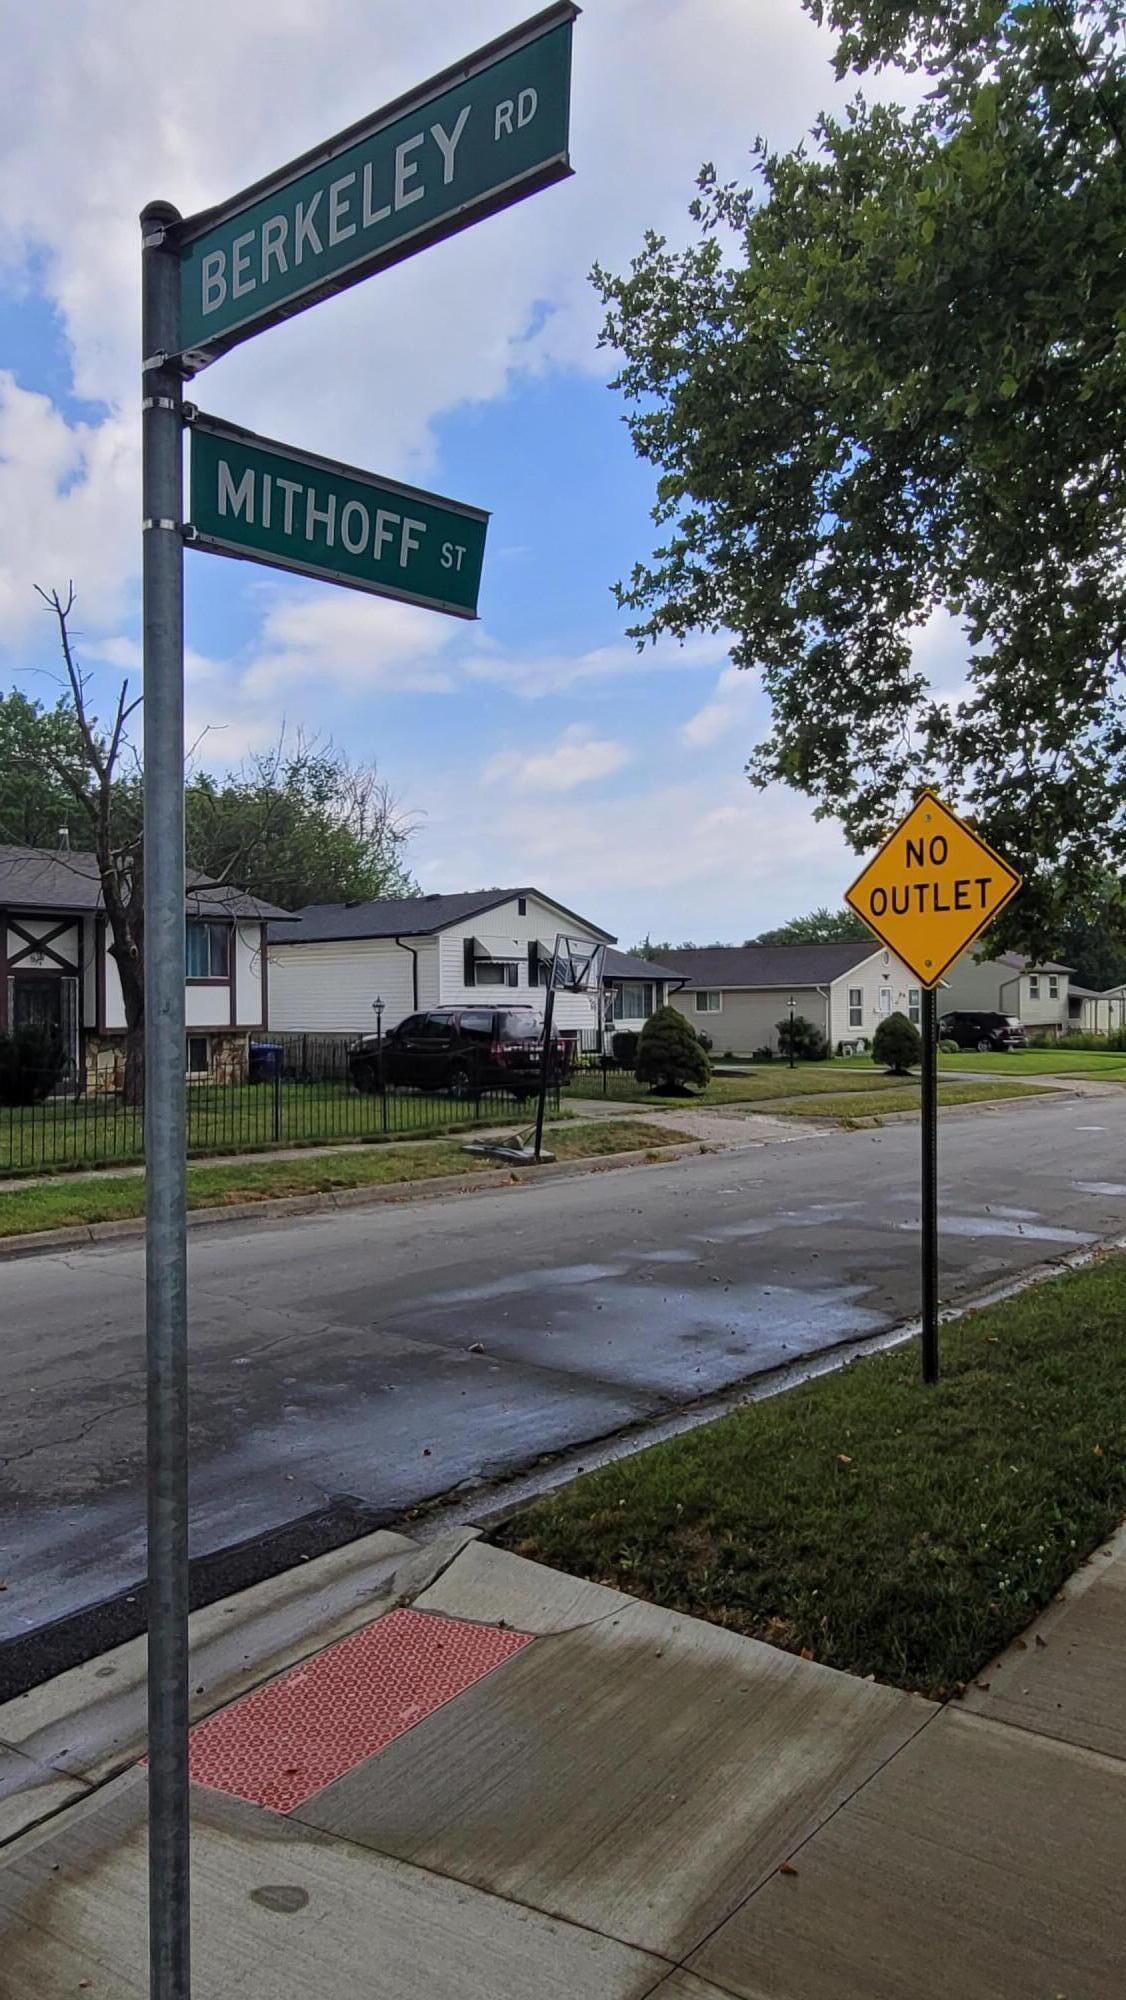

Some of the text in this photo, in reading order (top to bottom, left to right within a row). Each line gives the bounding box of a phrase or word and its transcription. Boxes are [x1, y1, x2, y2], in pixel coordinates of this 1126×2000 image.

[201, 88, 538, 316] BERKELEY RD
[217, 460, 467, 571] MITHOFF ST
[906, 835, 948, 868] NO
[869, 877, 992, 917] OUTLET
